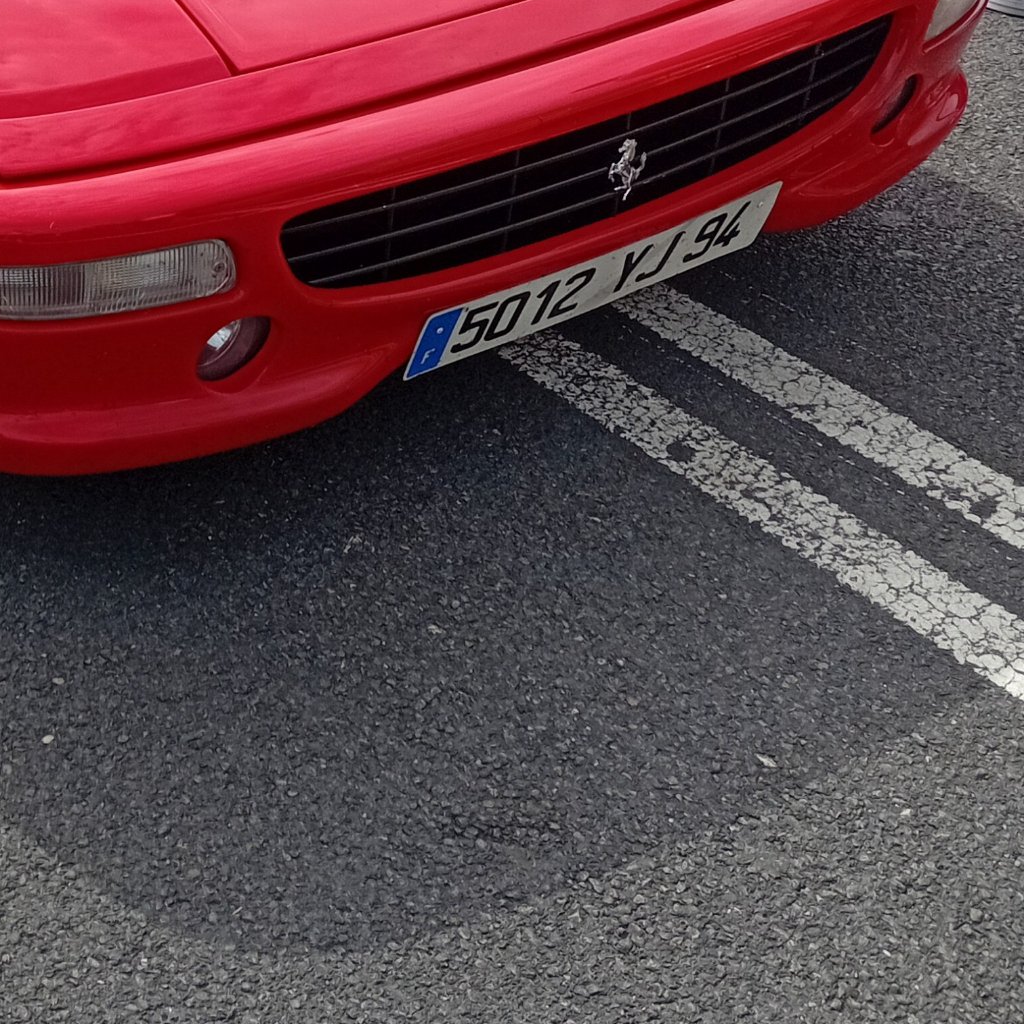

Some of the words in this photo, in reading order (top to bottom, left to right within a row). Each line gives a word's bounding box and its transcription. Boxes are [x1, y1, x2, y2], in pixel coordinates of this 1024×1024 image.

[450, 267, 597, 353] 5012
[613, 230, 686, 293] YJ
[682, 200, 751, 263] 94
[420, 347, 436, 365] F
